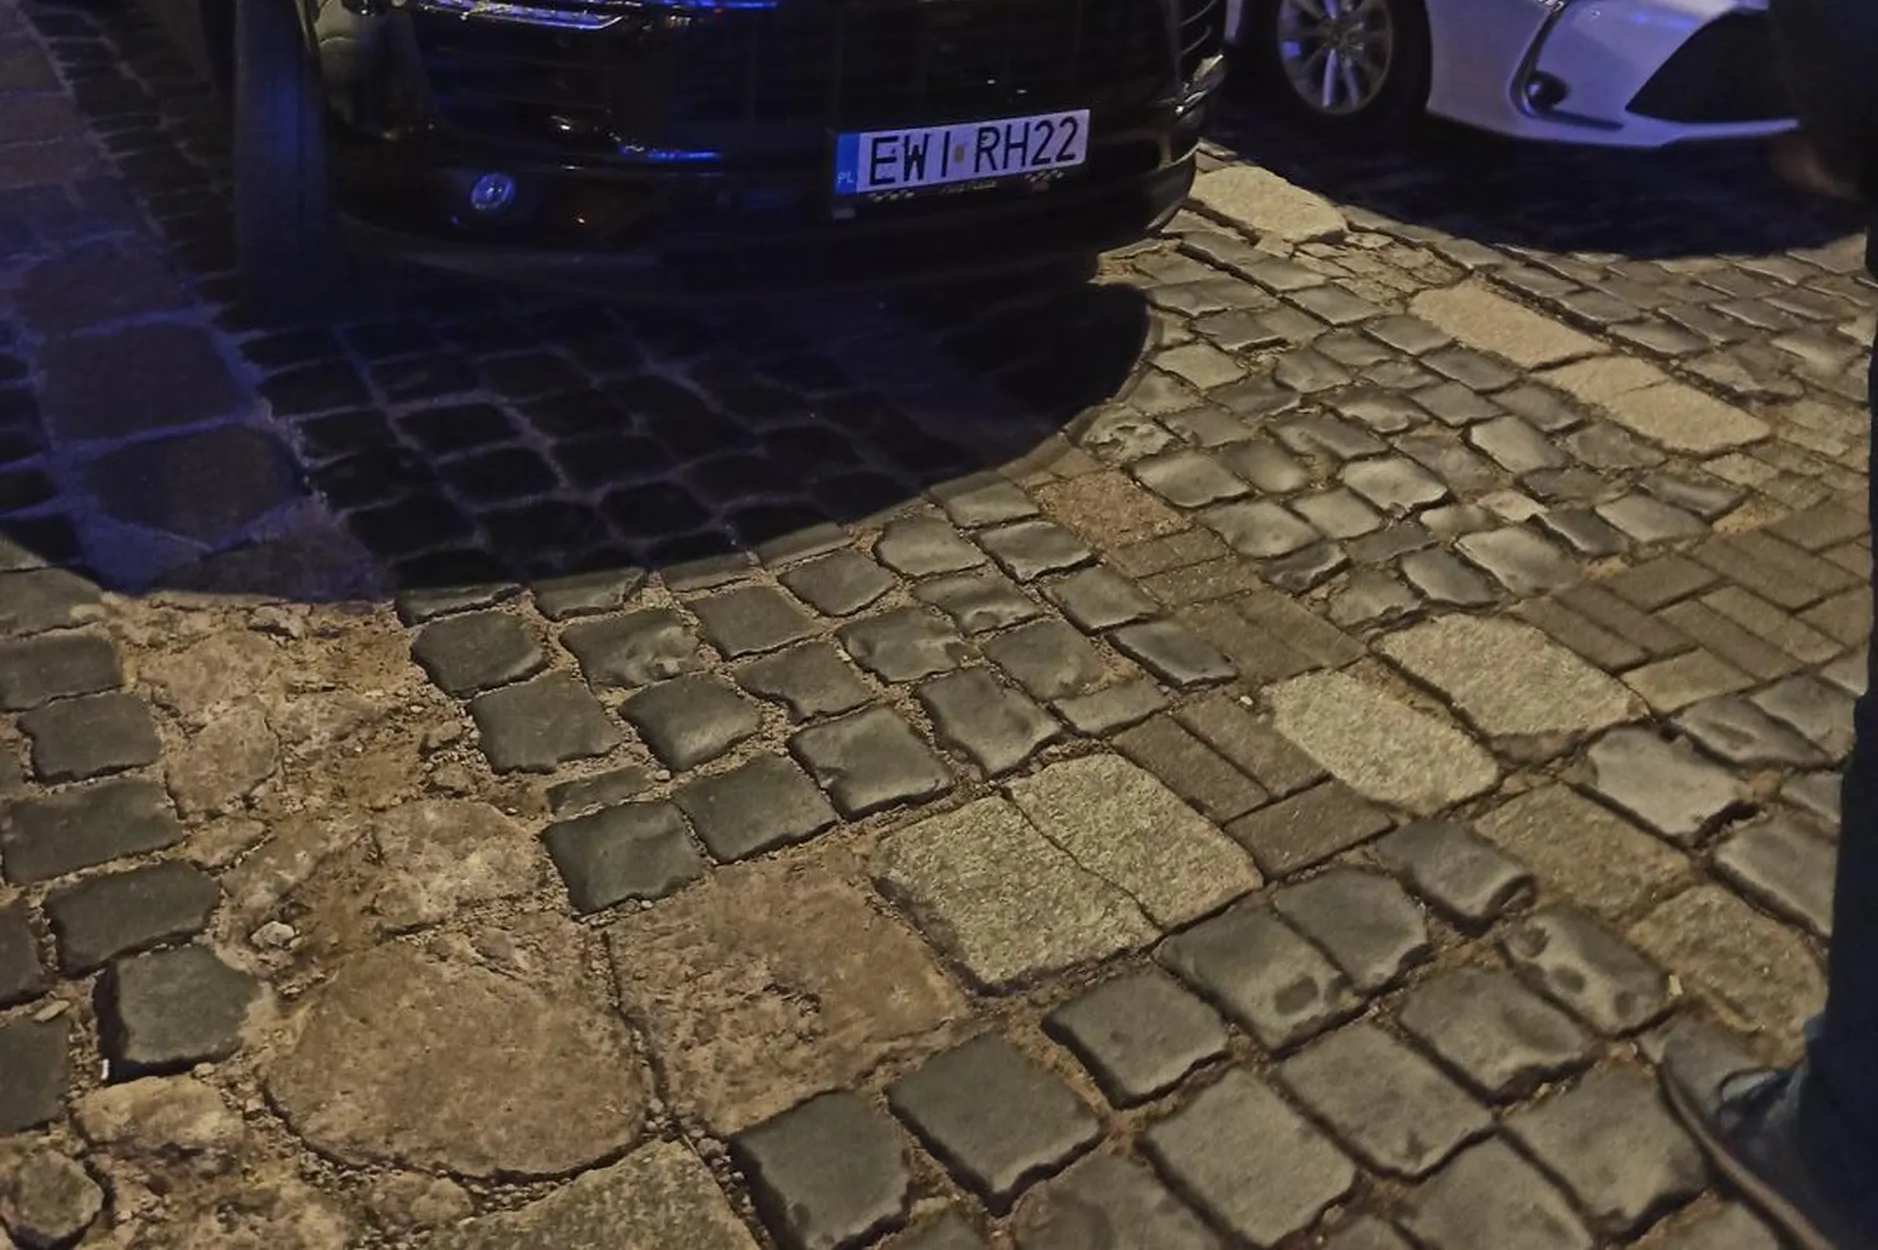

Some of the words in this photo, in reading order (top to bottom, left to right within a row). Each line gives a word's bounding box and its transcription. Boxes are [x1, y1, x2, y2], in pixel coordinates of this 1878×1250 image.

[869, 131, 951, 186] EWI
[973, 116, 1079, 173] RH22
[837, 171, 855, 186] PL
